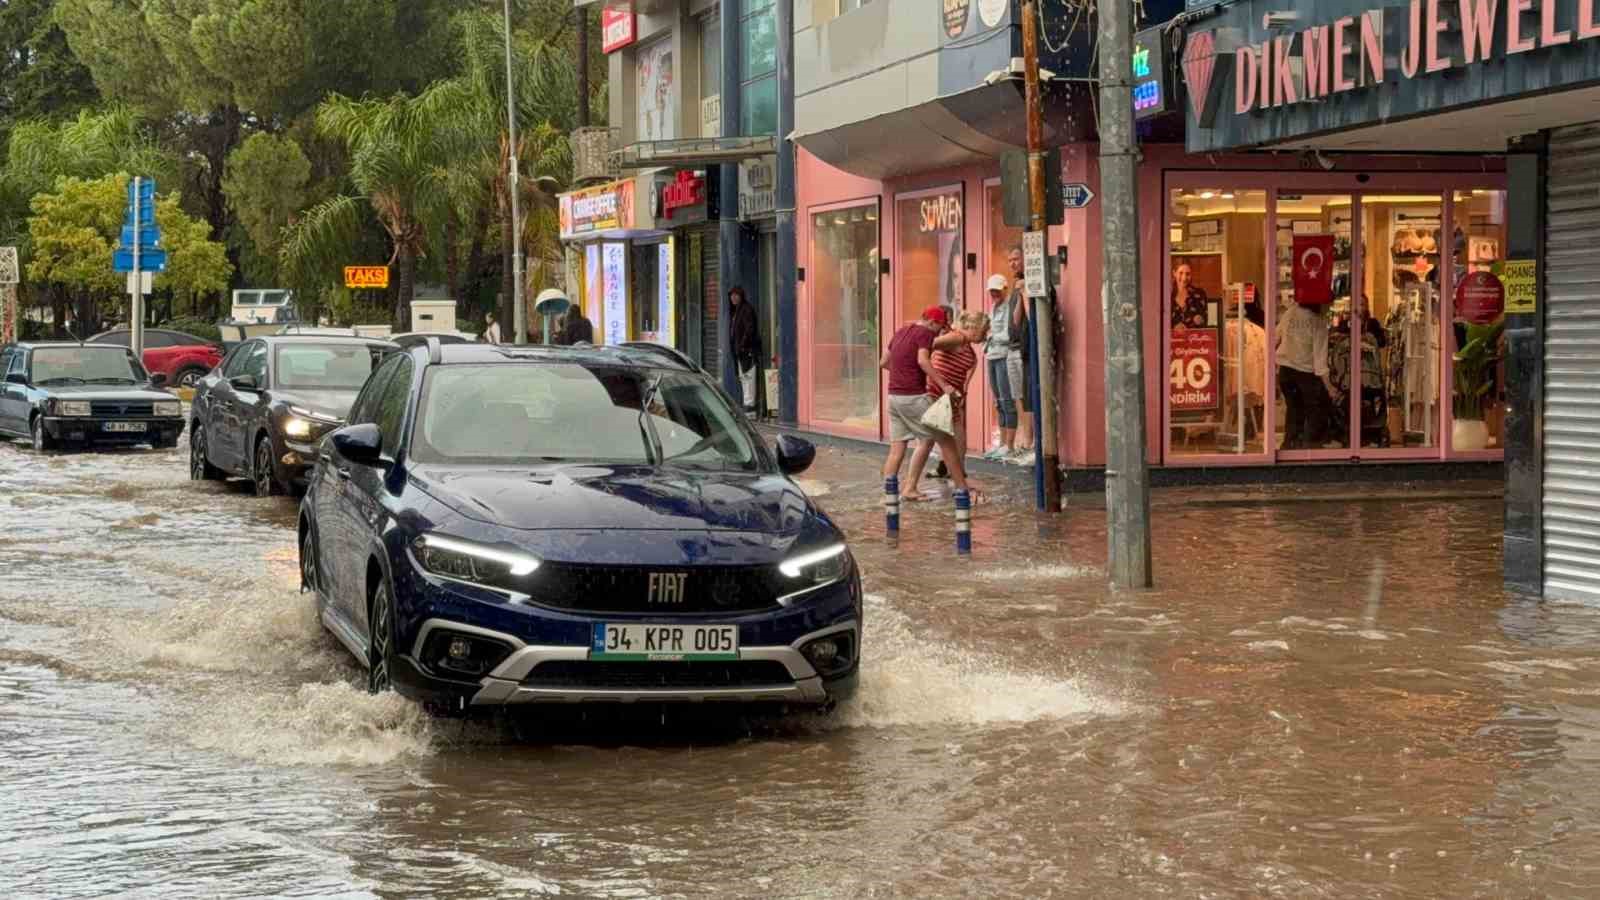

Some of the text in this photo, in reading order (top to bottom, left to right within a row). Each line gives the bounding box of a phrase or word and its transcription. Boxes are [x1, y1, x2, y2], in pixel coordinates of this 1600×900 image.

[1505, 263, 1537, 280] CHANG
[1507, 282, 1537, 297] OFFICE
[1169, 357, 1212, 390] 40
[647, 572, 688, 604] FIAT
[607, 626, 733, 651] 34 KPR 005
